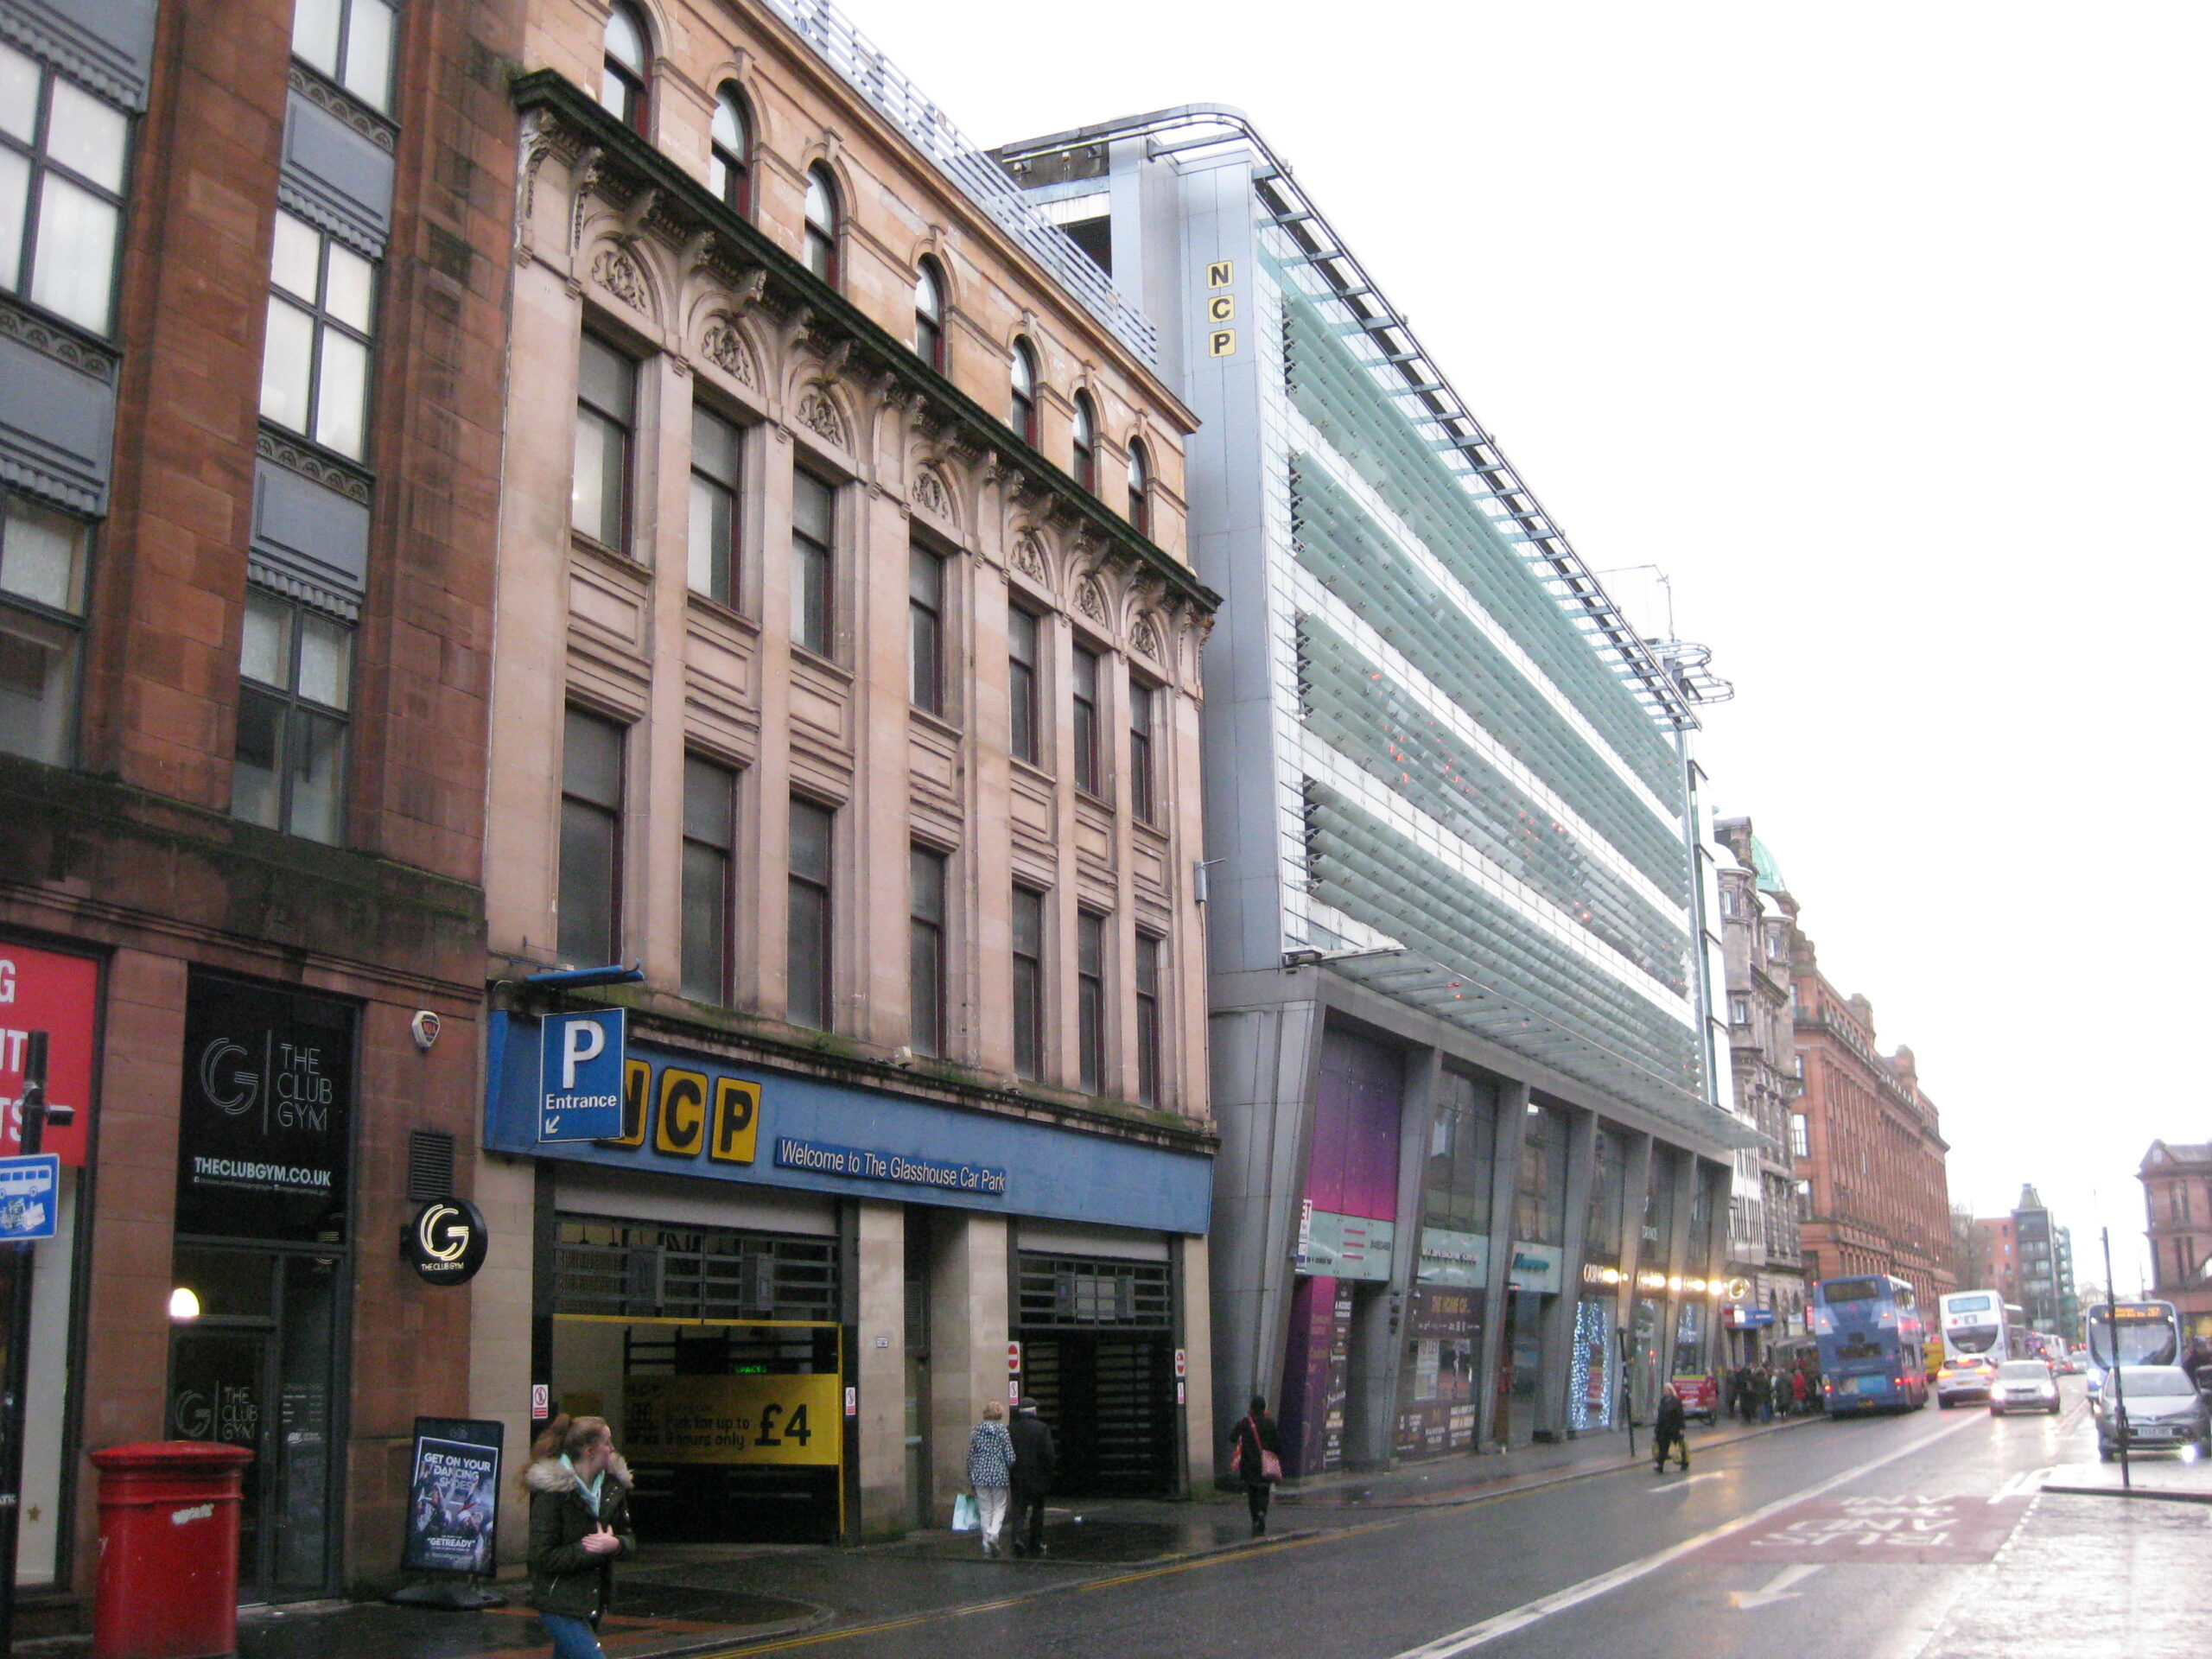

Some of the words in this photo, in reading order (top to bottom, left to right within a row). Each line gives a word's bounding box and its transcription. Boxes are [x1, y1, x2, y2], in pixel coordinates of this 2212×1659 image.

[1211, 264, 1230, 354] NCP
[280, 1043, 321, 1075] THE
[563, 1020, 605, 1089] P
[277, 1072, 333, 1104] CLUB
[545, 1093, 617, 1110] Entrance
[277, 1101, 327, 1131] GYM
[194, 1156, 331, 1186] THECLUBGYM.CO.UK
[781, 1139, 844, 1170] Welcome
[849, 1151, 860, 1173] to
[864, 1153, 887, 1177] The
[890, 1156, 957, 1185] Glasshouse
[960, 1166, 979, 1189] Car
[982, 1169, 1006, 1192] Park
[224, 1387, 250, 1404] THE
[221, 1404, 258, 1421] CLUB
[754, 1403, 811, 1446] £4
[222, 1422, 255, 1440] GYM
[715, 1432, 746, 1451] only
[423, 1452, 444, 1464] GET
[446, 1456, 461, 1467] ON
[463, 1458, 491, 1471] YOUR
[434, 1465, 480, 1480] DANCING
